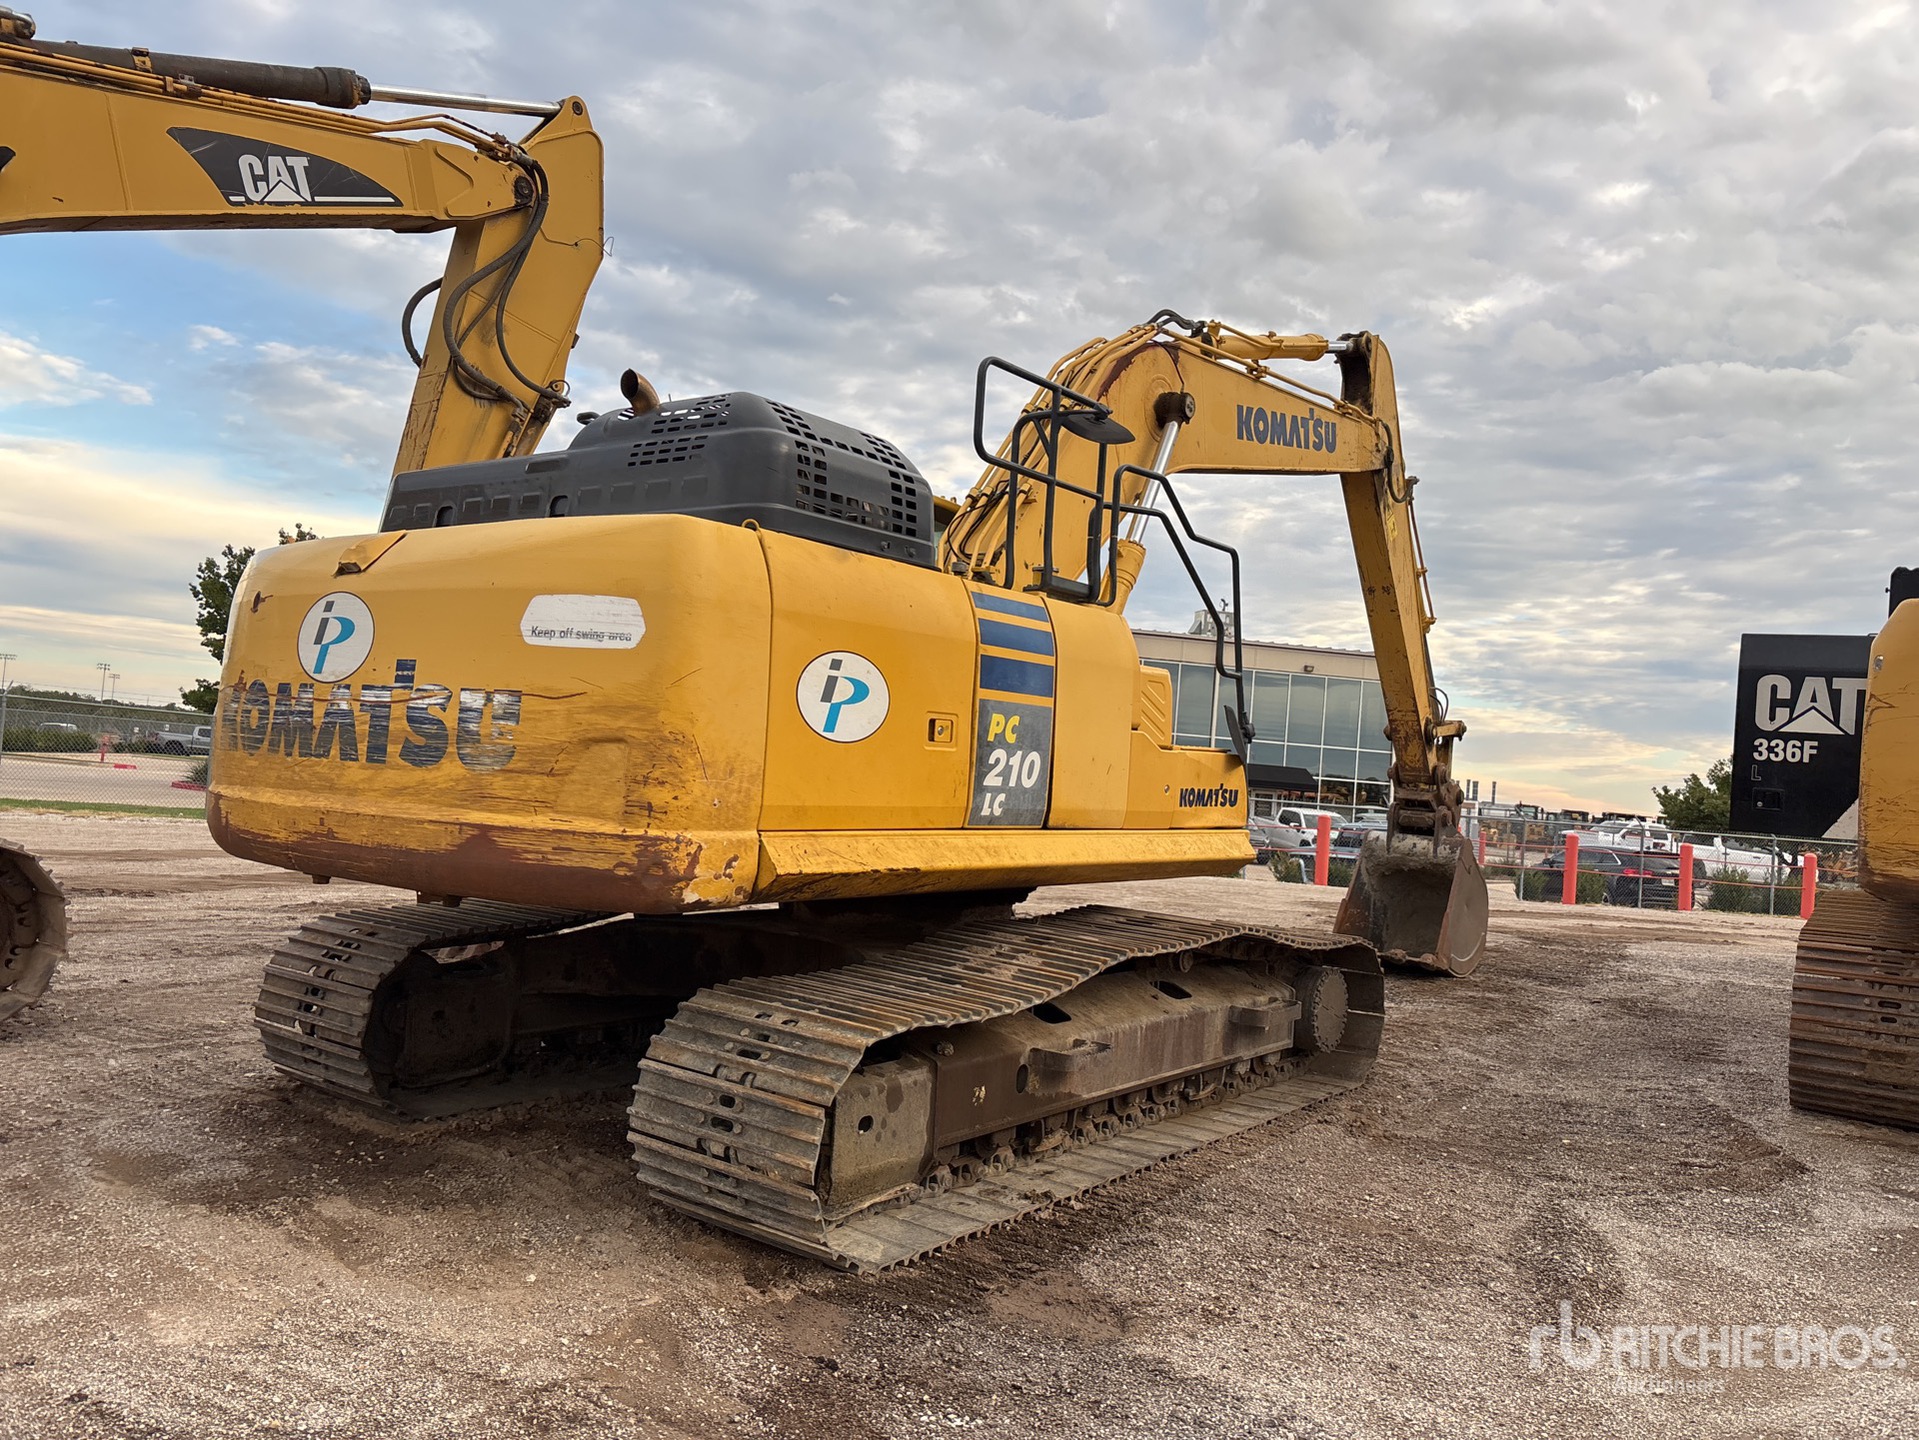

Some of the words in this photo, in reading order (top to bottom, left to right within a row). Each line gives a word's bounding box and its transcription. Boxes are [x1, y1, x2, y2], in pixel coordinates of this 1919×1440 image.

[238, 154, 312, 202] CAT
[1237, 404, 1337, 454] KOMATSU
[531, 625, 556, 640] Keep
[560, 627, 574, 639] off
[1755, 674, 1869, 735] CAT
[987, 713, 1021, 744] PC
[1753, 738, 1819, 763] 336F
[983, 748, 1042, 788] 210
[980, 793, 1006, 816] LC
[1179, 783, 1239, 808] KOMATSU
